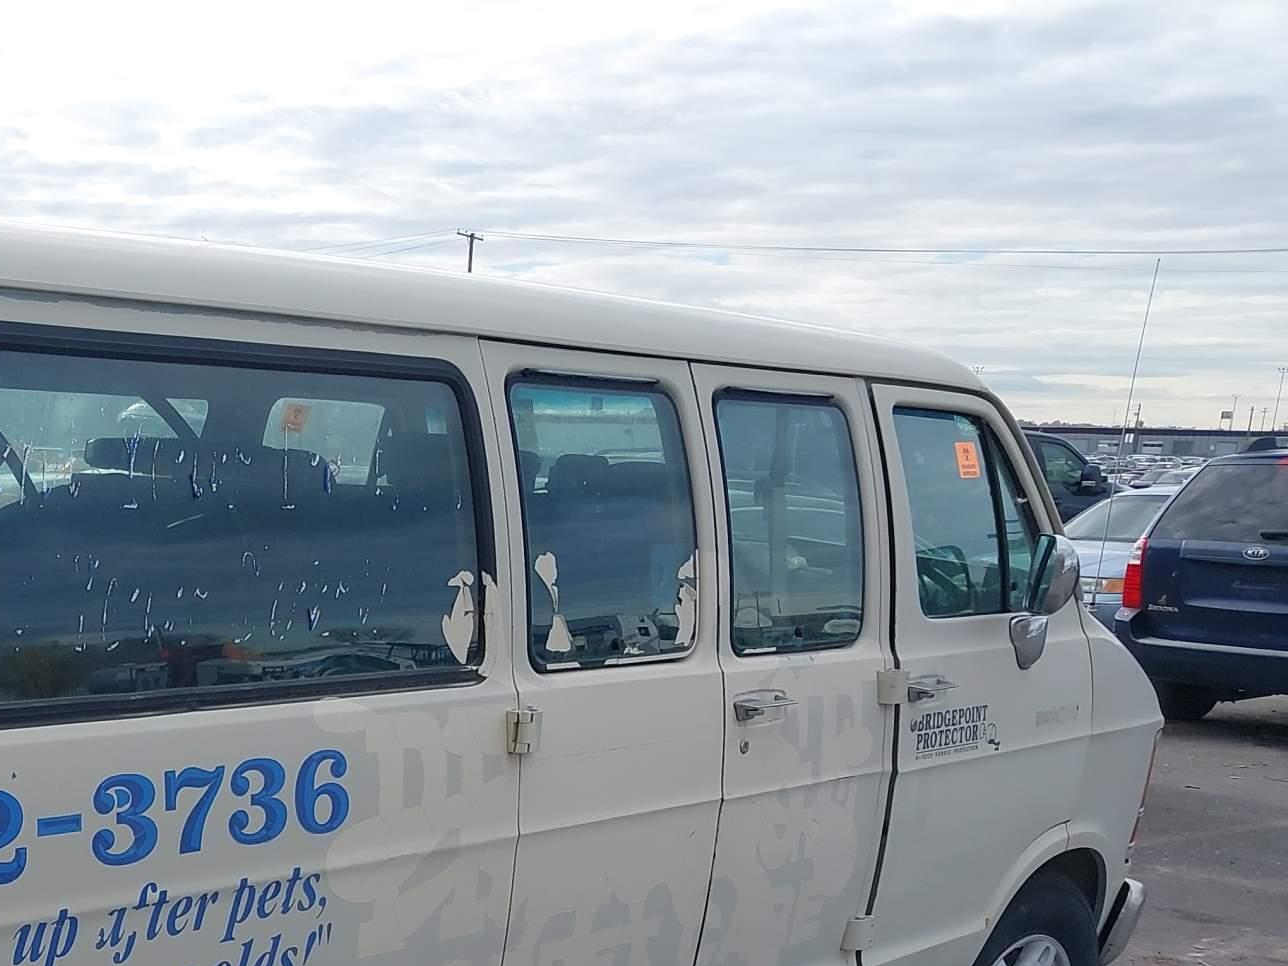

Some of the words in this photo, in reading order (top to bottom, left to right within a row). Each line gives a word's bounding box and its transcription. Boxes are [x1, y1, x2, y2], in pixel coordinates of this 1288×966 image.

[1246, 549, 1268, 558] KIA
[916, 724, 979, 751] PROTECTOR
[96, 882, 220, 965] after
[218, 867, 329, 944] pets,
